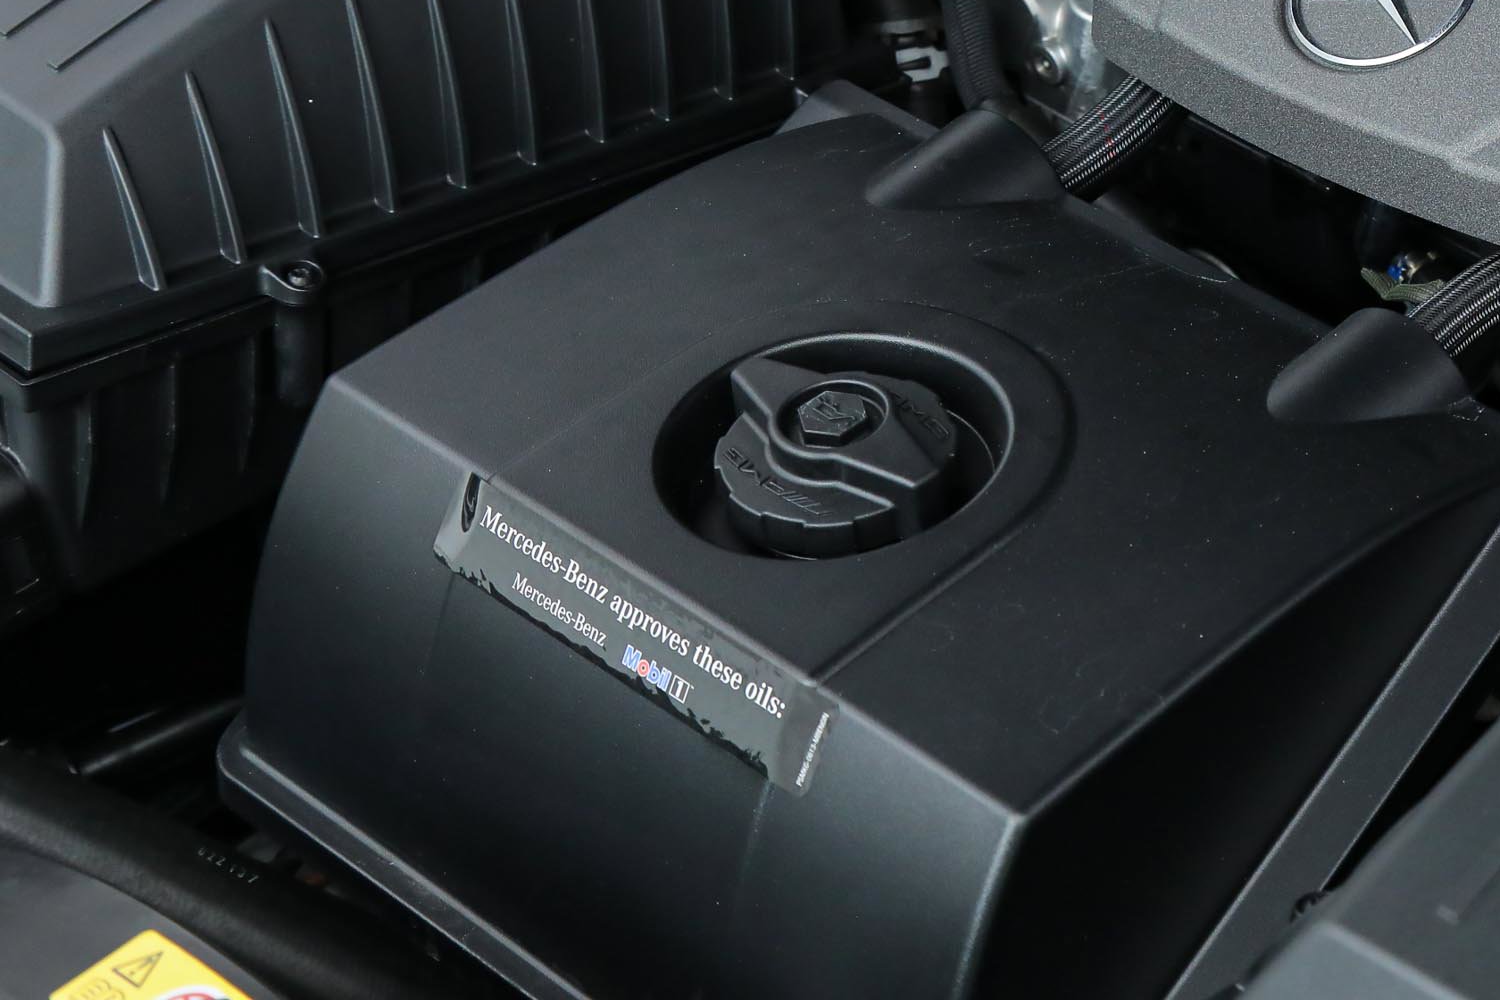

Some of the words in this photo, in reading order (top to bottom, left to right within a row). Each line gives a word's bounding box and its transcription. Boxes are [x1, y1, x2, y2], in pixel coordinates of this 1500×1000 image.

[479, 505, 609, 604] Mercedes-Benz
[610, 593, 691, 658] approves
[692, 644, 744, 691] these
[744, 678, 787, 719] oils:
[511, 571, 607, 649] Mercedes-Benz
[621, 643, 673, 692] Mobil
